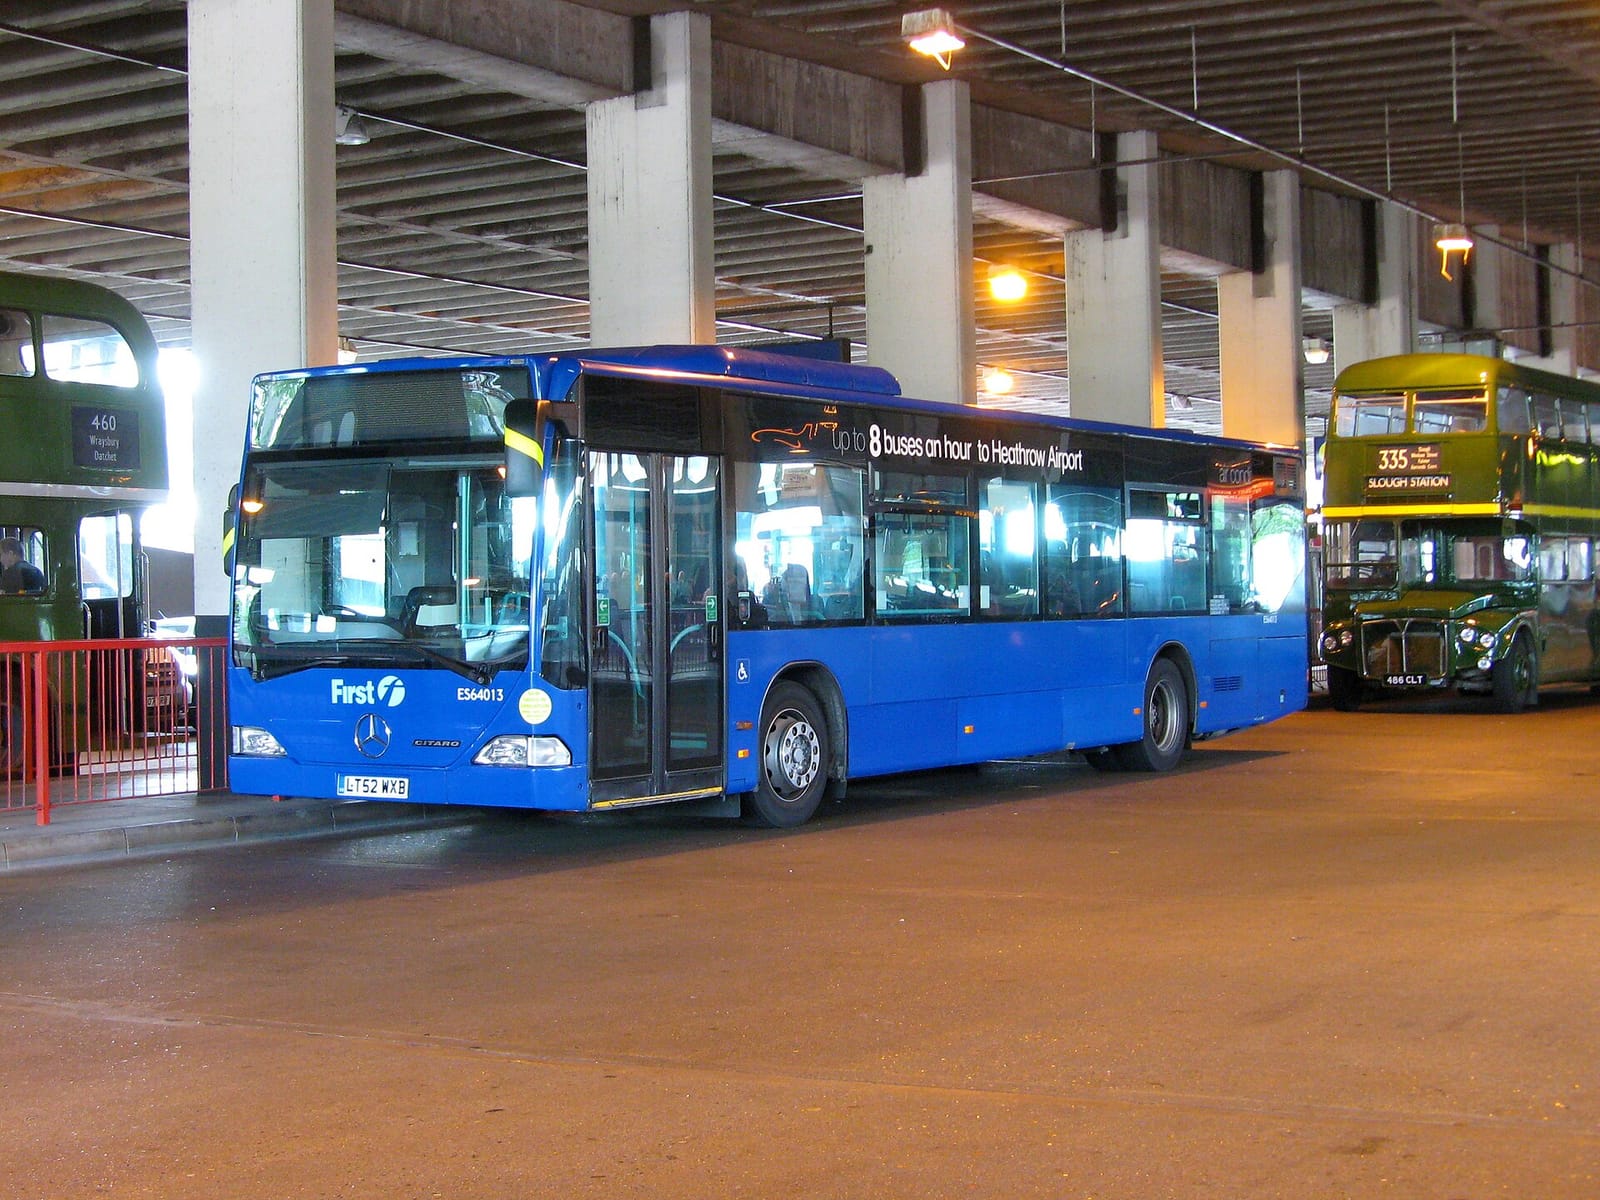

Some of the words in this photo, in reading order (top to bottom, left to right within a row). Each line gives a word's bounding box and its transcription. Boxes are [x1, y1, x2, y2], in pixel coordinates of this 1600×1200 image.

[91, 414, 117, 431] 460
[832, 428, 852, 454] up
[852, 431, 866, 452] to
[869, 423, 882, 458] 8
[883, 430, 923, 457] buses
[925, 439, 943, 458] an
[944, 433, 971, 460] hour
[978, 441, 990, 463] to
[991, 439, 1046, 467] Heathrow
[1048, 443, 1083, 475] Airport
[1378, 448, 1408, 470] 335
[1367, 476, 1408, 489] SLOUGH
[1410, 475, 1449, 487] STATION
[1405, 675, 1423, 685] CLT
[331, 678, 375, 705] First
[457, 687, 504, 702] ES64013
[346, 777, 378, 794] LT52
[382, 779, 406, 795] WXB
